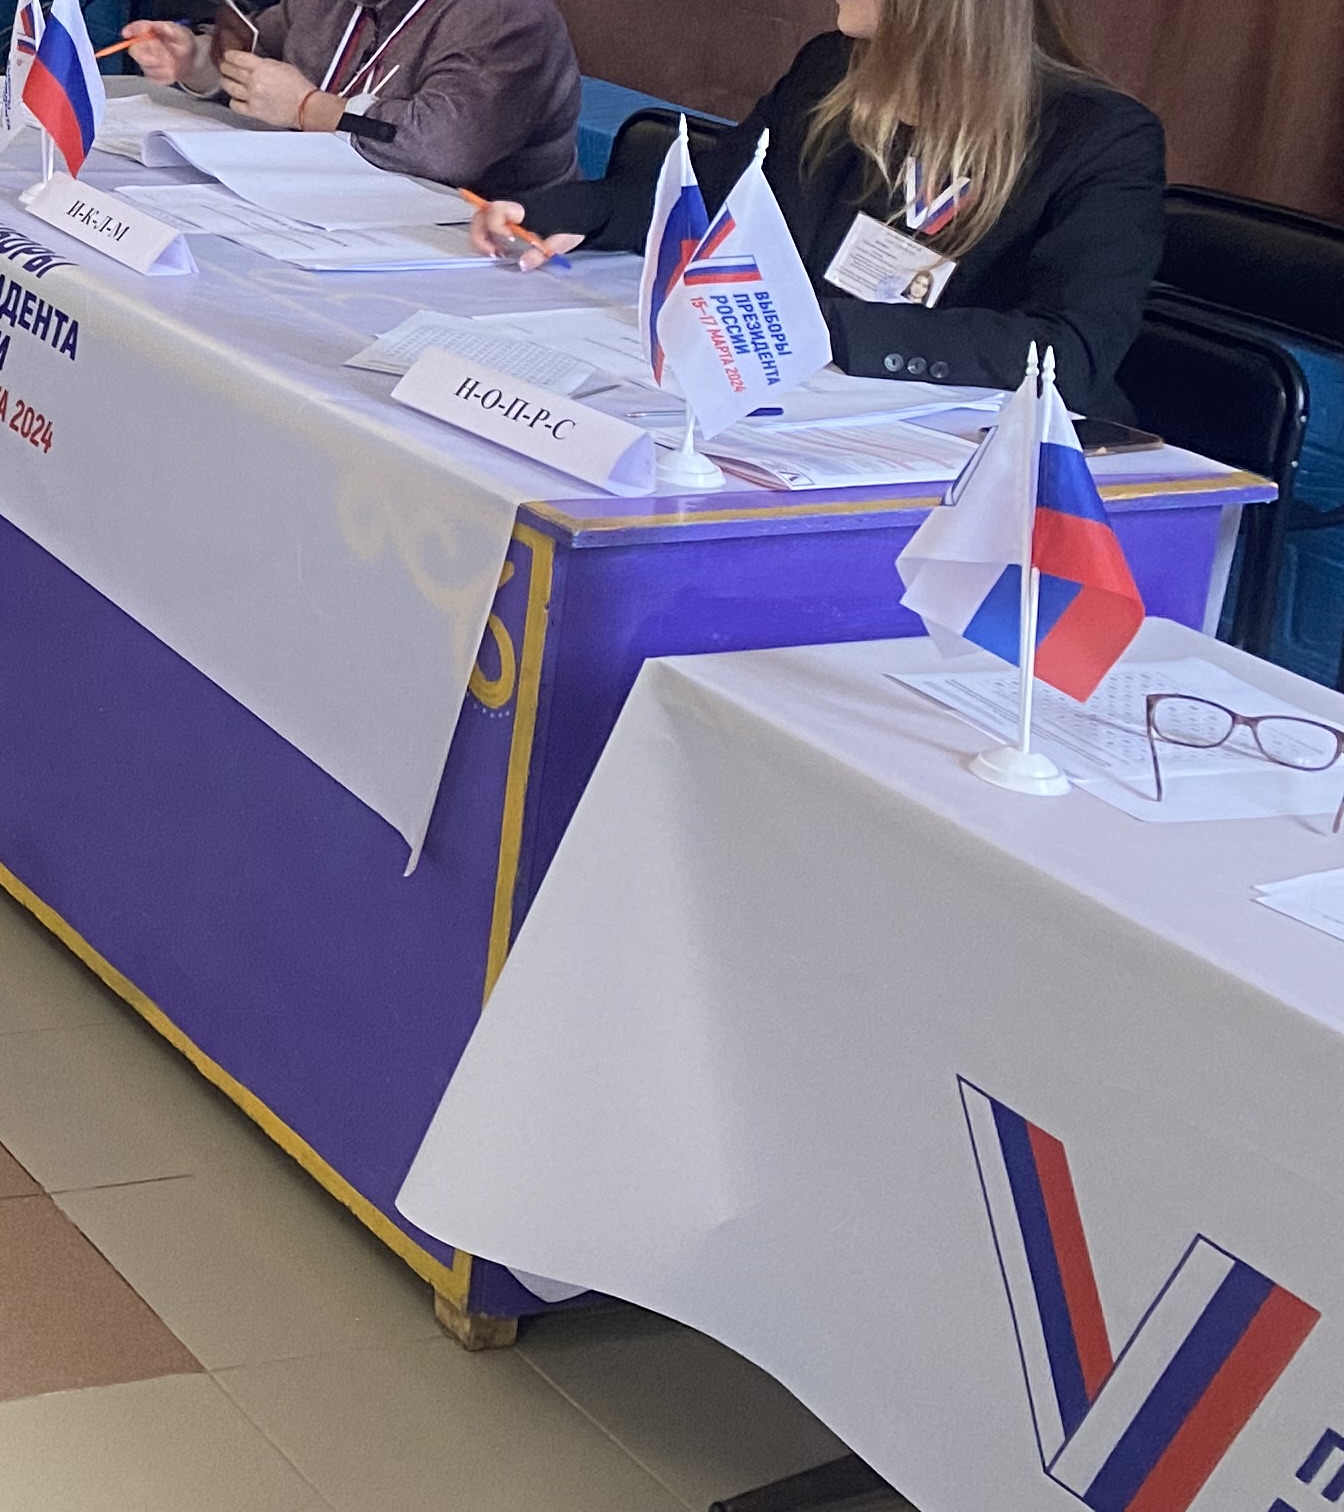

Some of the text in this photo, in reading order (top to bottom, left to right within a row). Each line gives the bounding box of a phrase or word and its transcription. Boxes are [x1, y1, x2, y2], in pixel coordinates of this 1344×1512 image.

[66, 199, 131, 242] И-К-Л-М
[709, 295, 751, 355] РОССИИ
[733, 293, 781, 386] ПРЕЗИДЕНТА
[754, 291, 793, 356] ВЫБОРЫ
[707, 328, 735, 366] МАРТА
[724, 367, 747, 393] 2024
[8, 399, 54, 454] 2024
[454, 376, 576, 441] Н-О-П-Р-С
